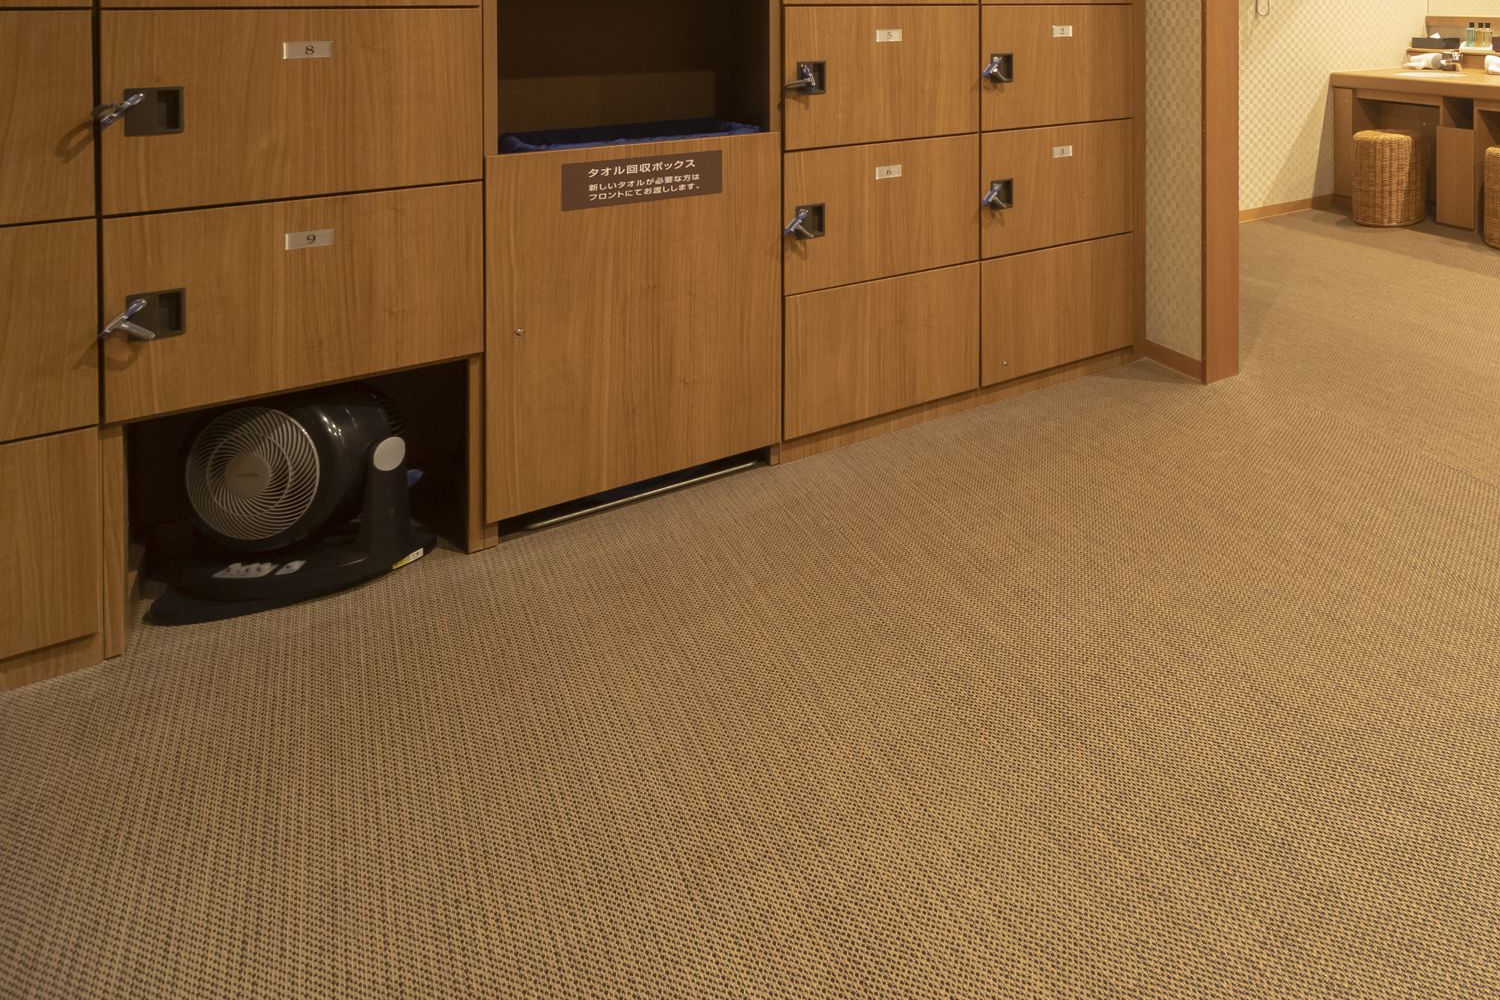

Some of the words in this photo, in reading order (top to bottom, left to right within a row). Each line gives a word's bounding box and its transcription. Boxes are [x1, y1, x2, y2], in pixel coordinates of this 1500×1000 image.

[887, 31, 893, 39] 5
[304, 44, 315, 56] 8
[587, 158, 696, 178] タオル回収ボックス
[886, 168, 892, 176] 6
[588, 173, 700, 192] 新しいタオルが必要な方は
[588, 183, 700, 202] フロントにてお渡しします。
[306, 233, 316, 245] 9
